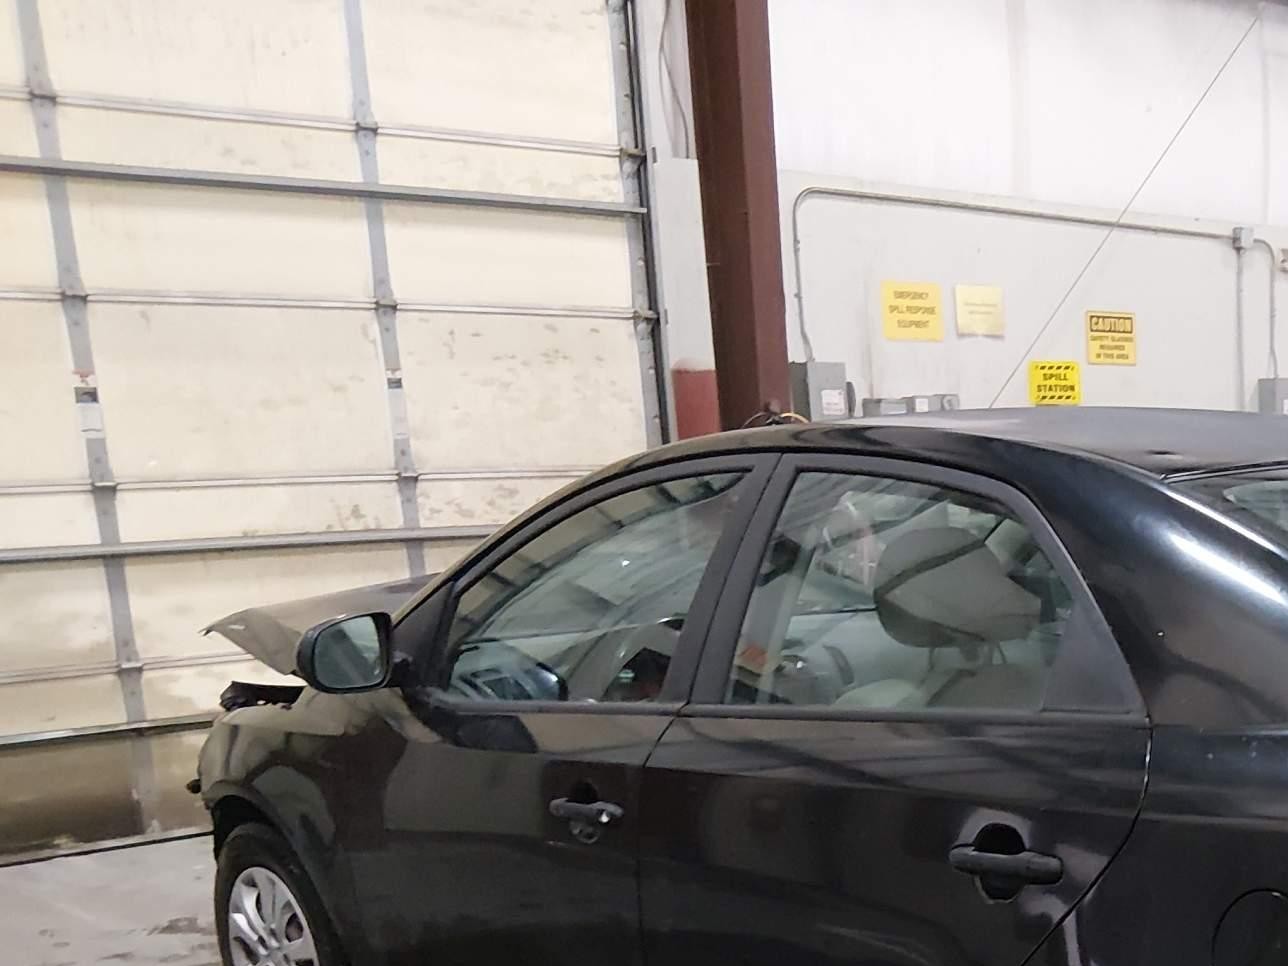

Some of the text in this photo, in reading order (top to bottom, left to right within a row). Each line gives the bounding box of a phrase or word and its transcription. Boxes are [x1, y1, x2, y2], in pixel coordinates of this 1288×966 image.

[1090, 316, 1132, 332] CAUTION
[1042, 372, 1069, 381] SPILL
[1036, 384, 1075, 393] STATION
